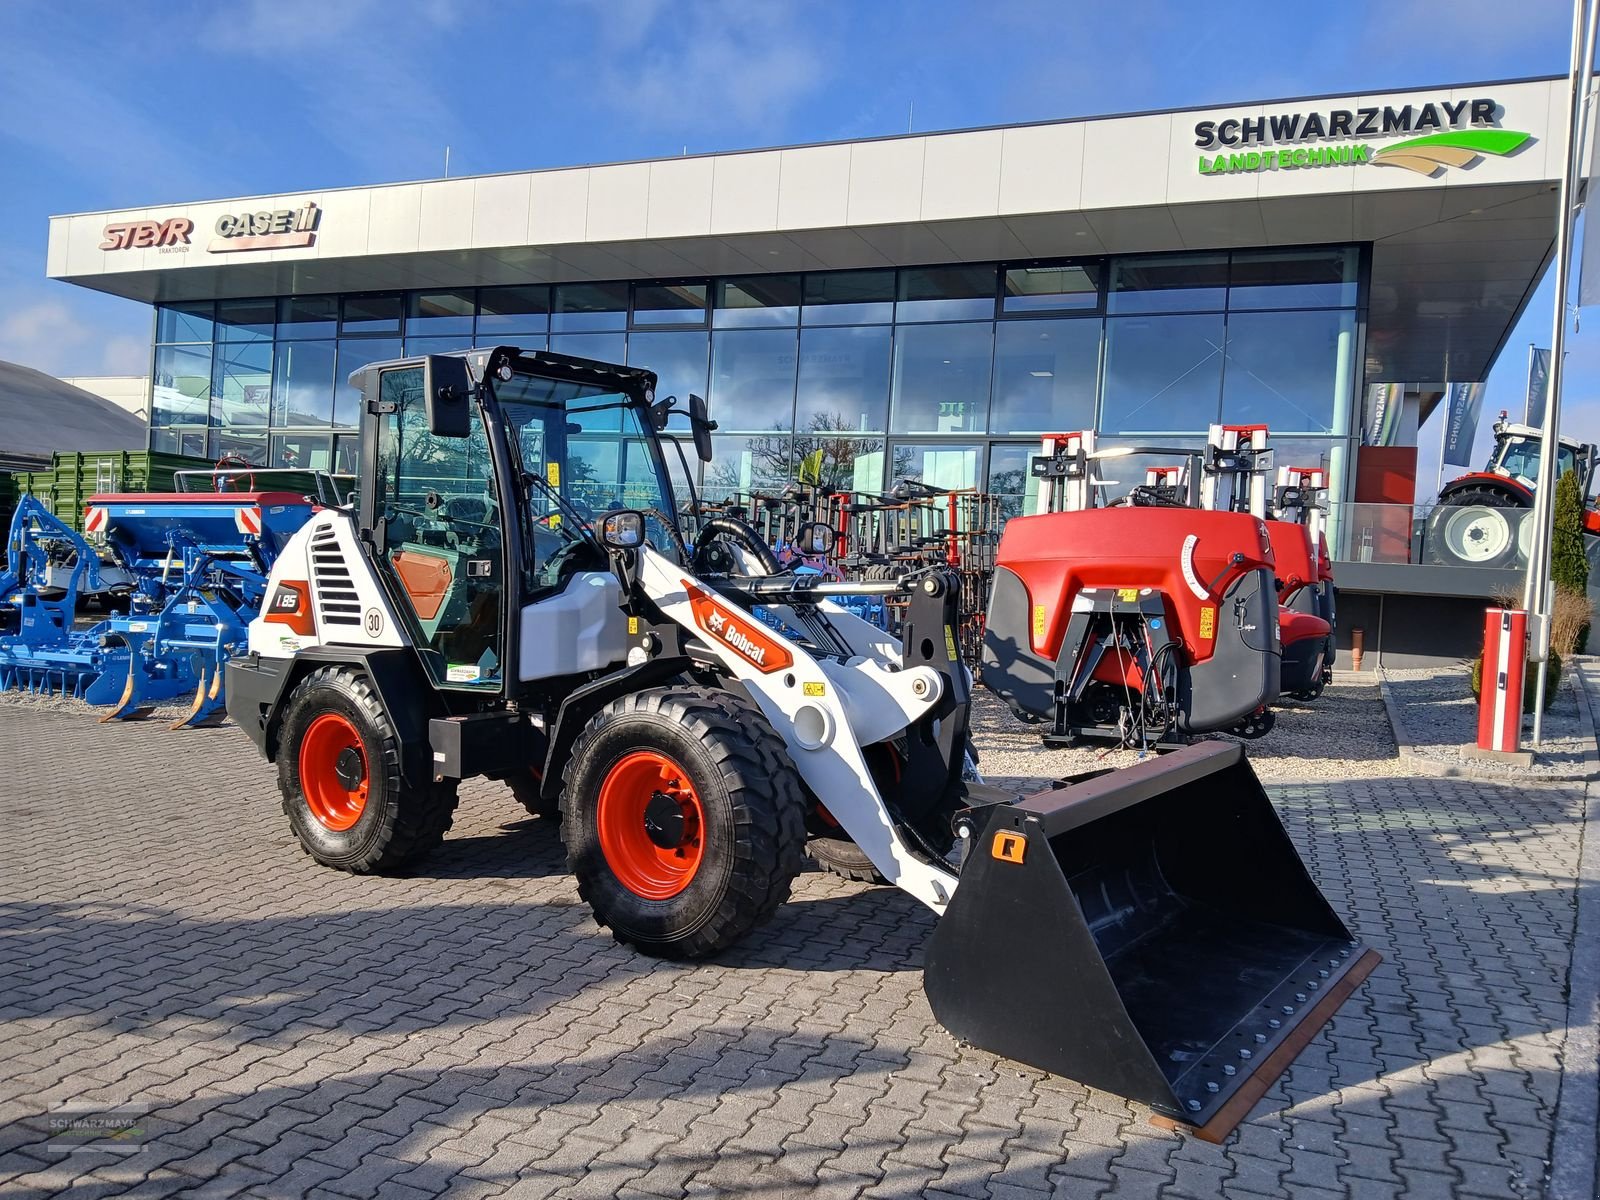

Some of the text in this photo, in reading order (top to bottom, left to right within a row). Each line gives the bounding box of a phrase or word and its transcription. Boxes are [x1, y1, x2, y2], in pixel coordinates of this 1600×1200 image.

[1194, 98, 1499, 147] SCHWARZMAYR
[1198, 144, 1369, 175] LANDTECHNIK
[99, 217, 194, 250] STEYR
[214, 209, 292, 238] CASE
[368, 614, 380, 631] 30
[724, 624, 766, 662] Bobcat
